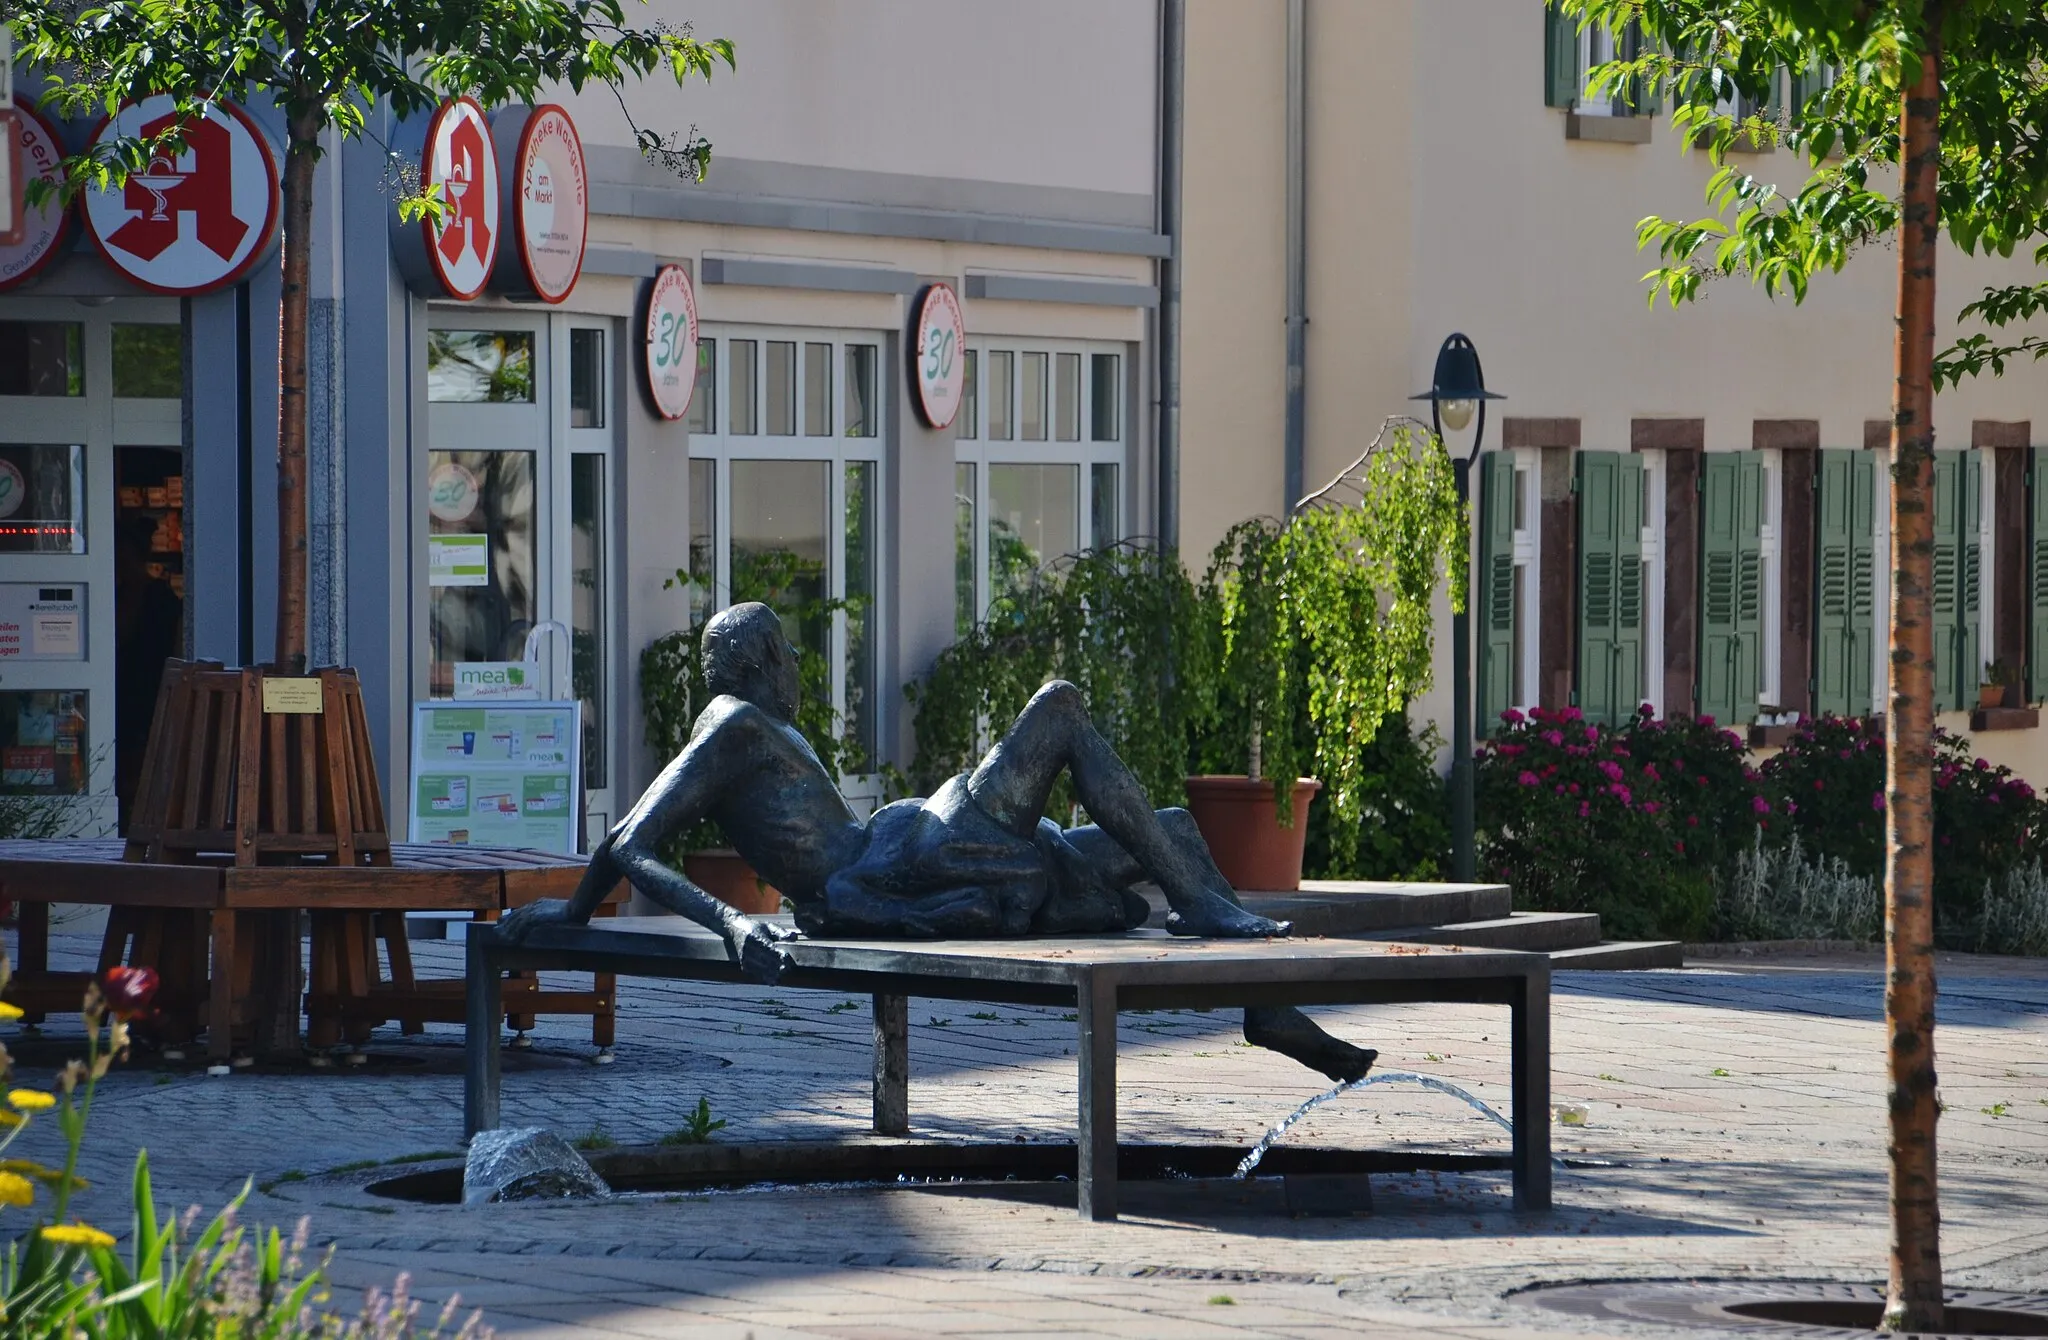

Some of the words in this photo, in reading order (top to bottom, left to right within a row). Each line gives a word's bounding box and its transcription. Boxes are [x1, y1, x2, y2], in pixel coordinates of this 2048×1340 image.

[16, 119, 55, 183] gerle
[523, 119, 553, 201] Apotheke
[556, 116, 583, 205] Waegerle
[535, 191, 553, 204] Markt
[538, 175, 549, 186] am
[2, 230, 51, 277] Gesundheit
[656, 311, 687, 368] 30
[926, 328, 955, 380] 30
[461, 670, 506, 684] mea
[529, 752, 554, 762] mea
